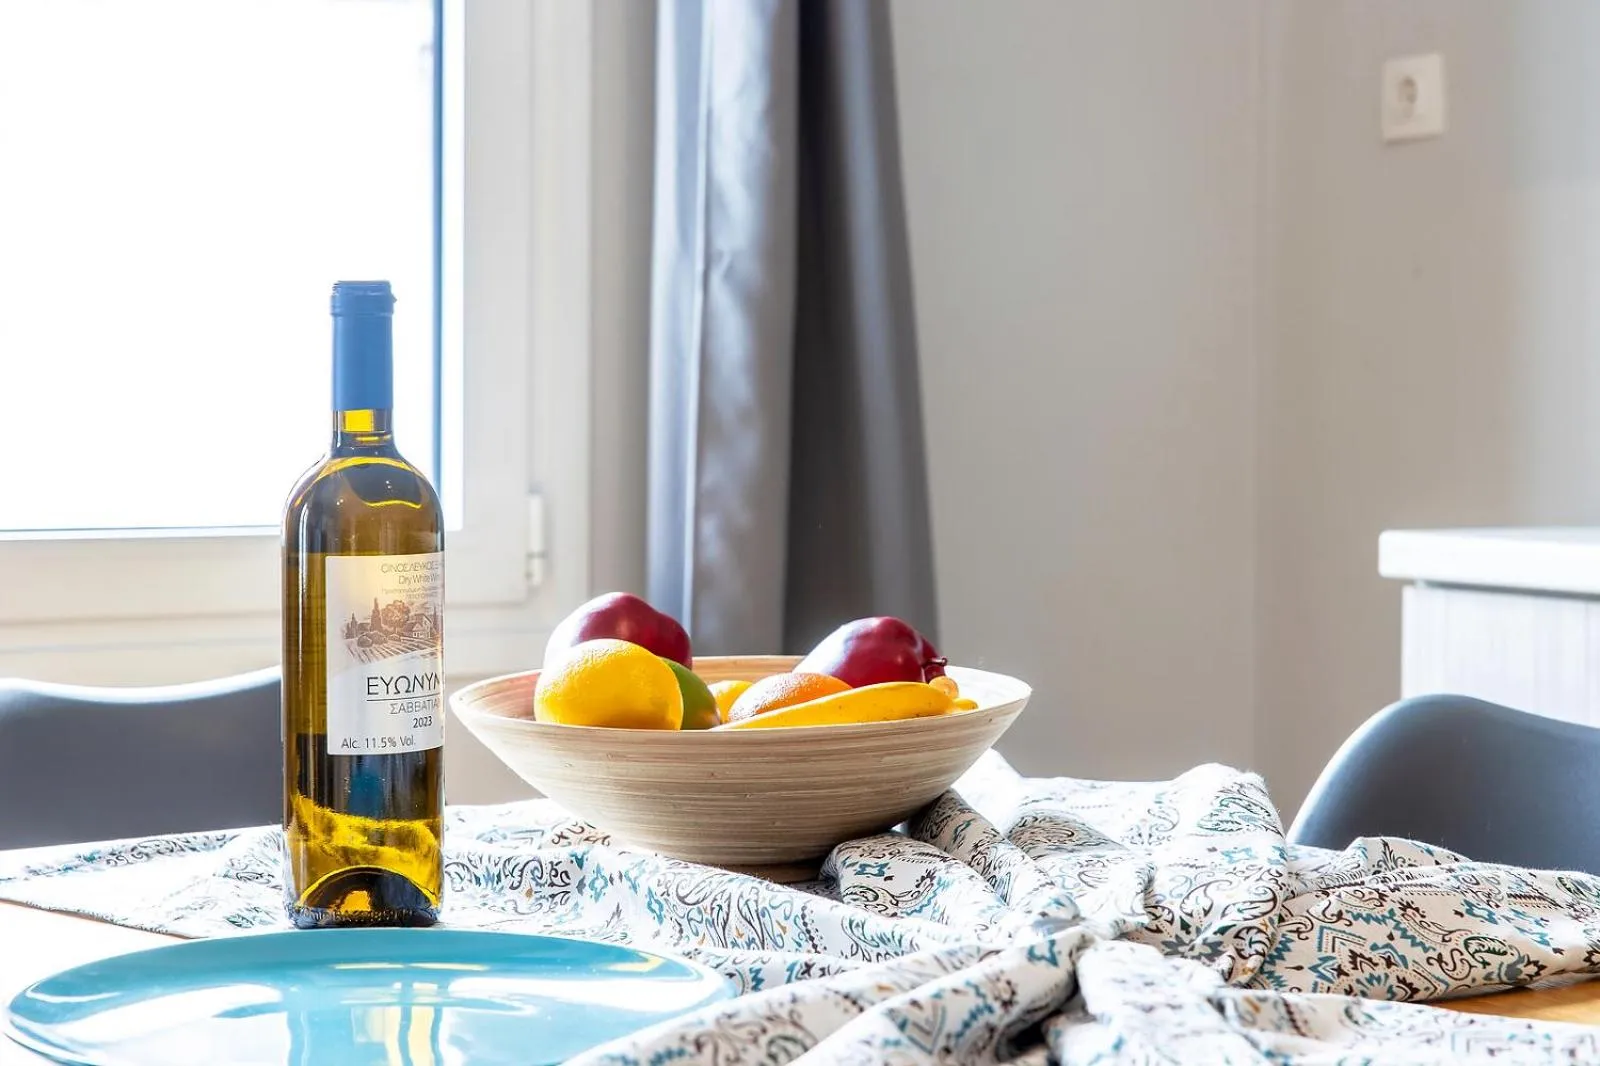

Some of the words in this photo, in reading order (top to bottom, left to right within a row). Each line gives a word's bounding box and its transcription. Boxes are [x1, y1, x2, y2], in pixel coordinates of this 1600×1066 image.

[399, 575, 411, 586] Dry
[413, 716, 432, 728] 2023
[341, 737, 361, 749] Alc.
[365, 737, 397, 748] 11.5%
[400, 735, 416, 746] Vol.
